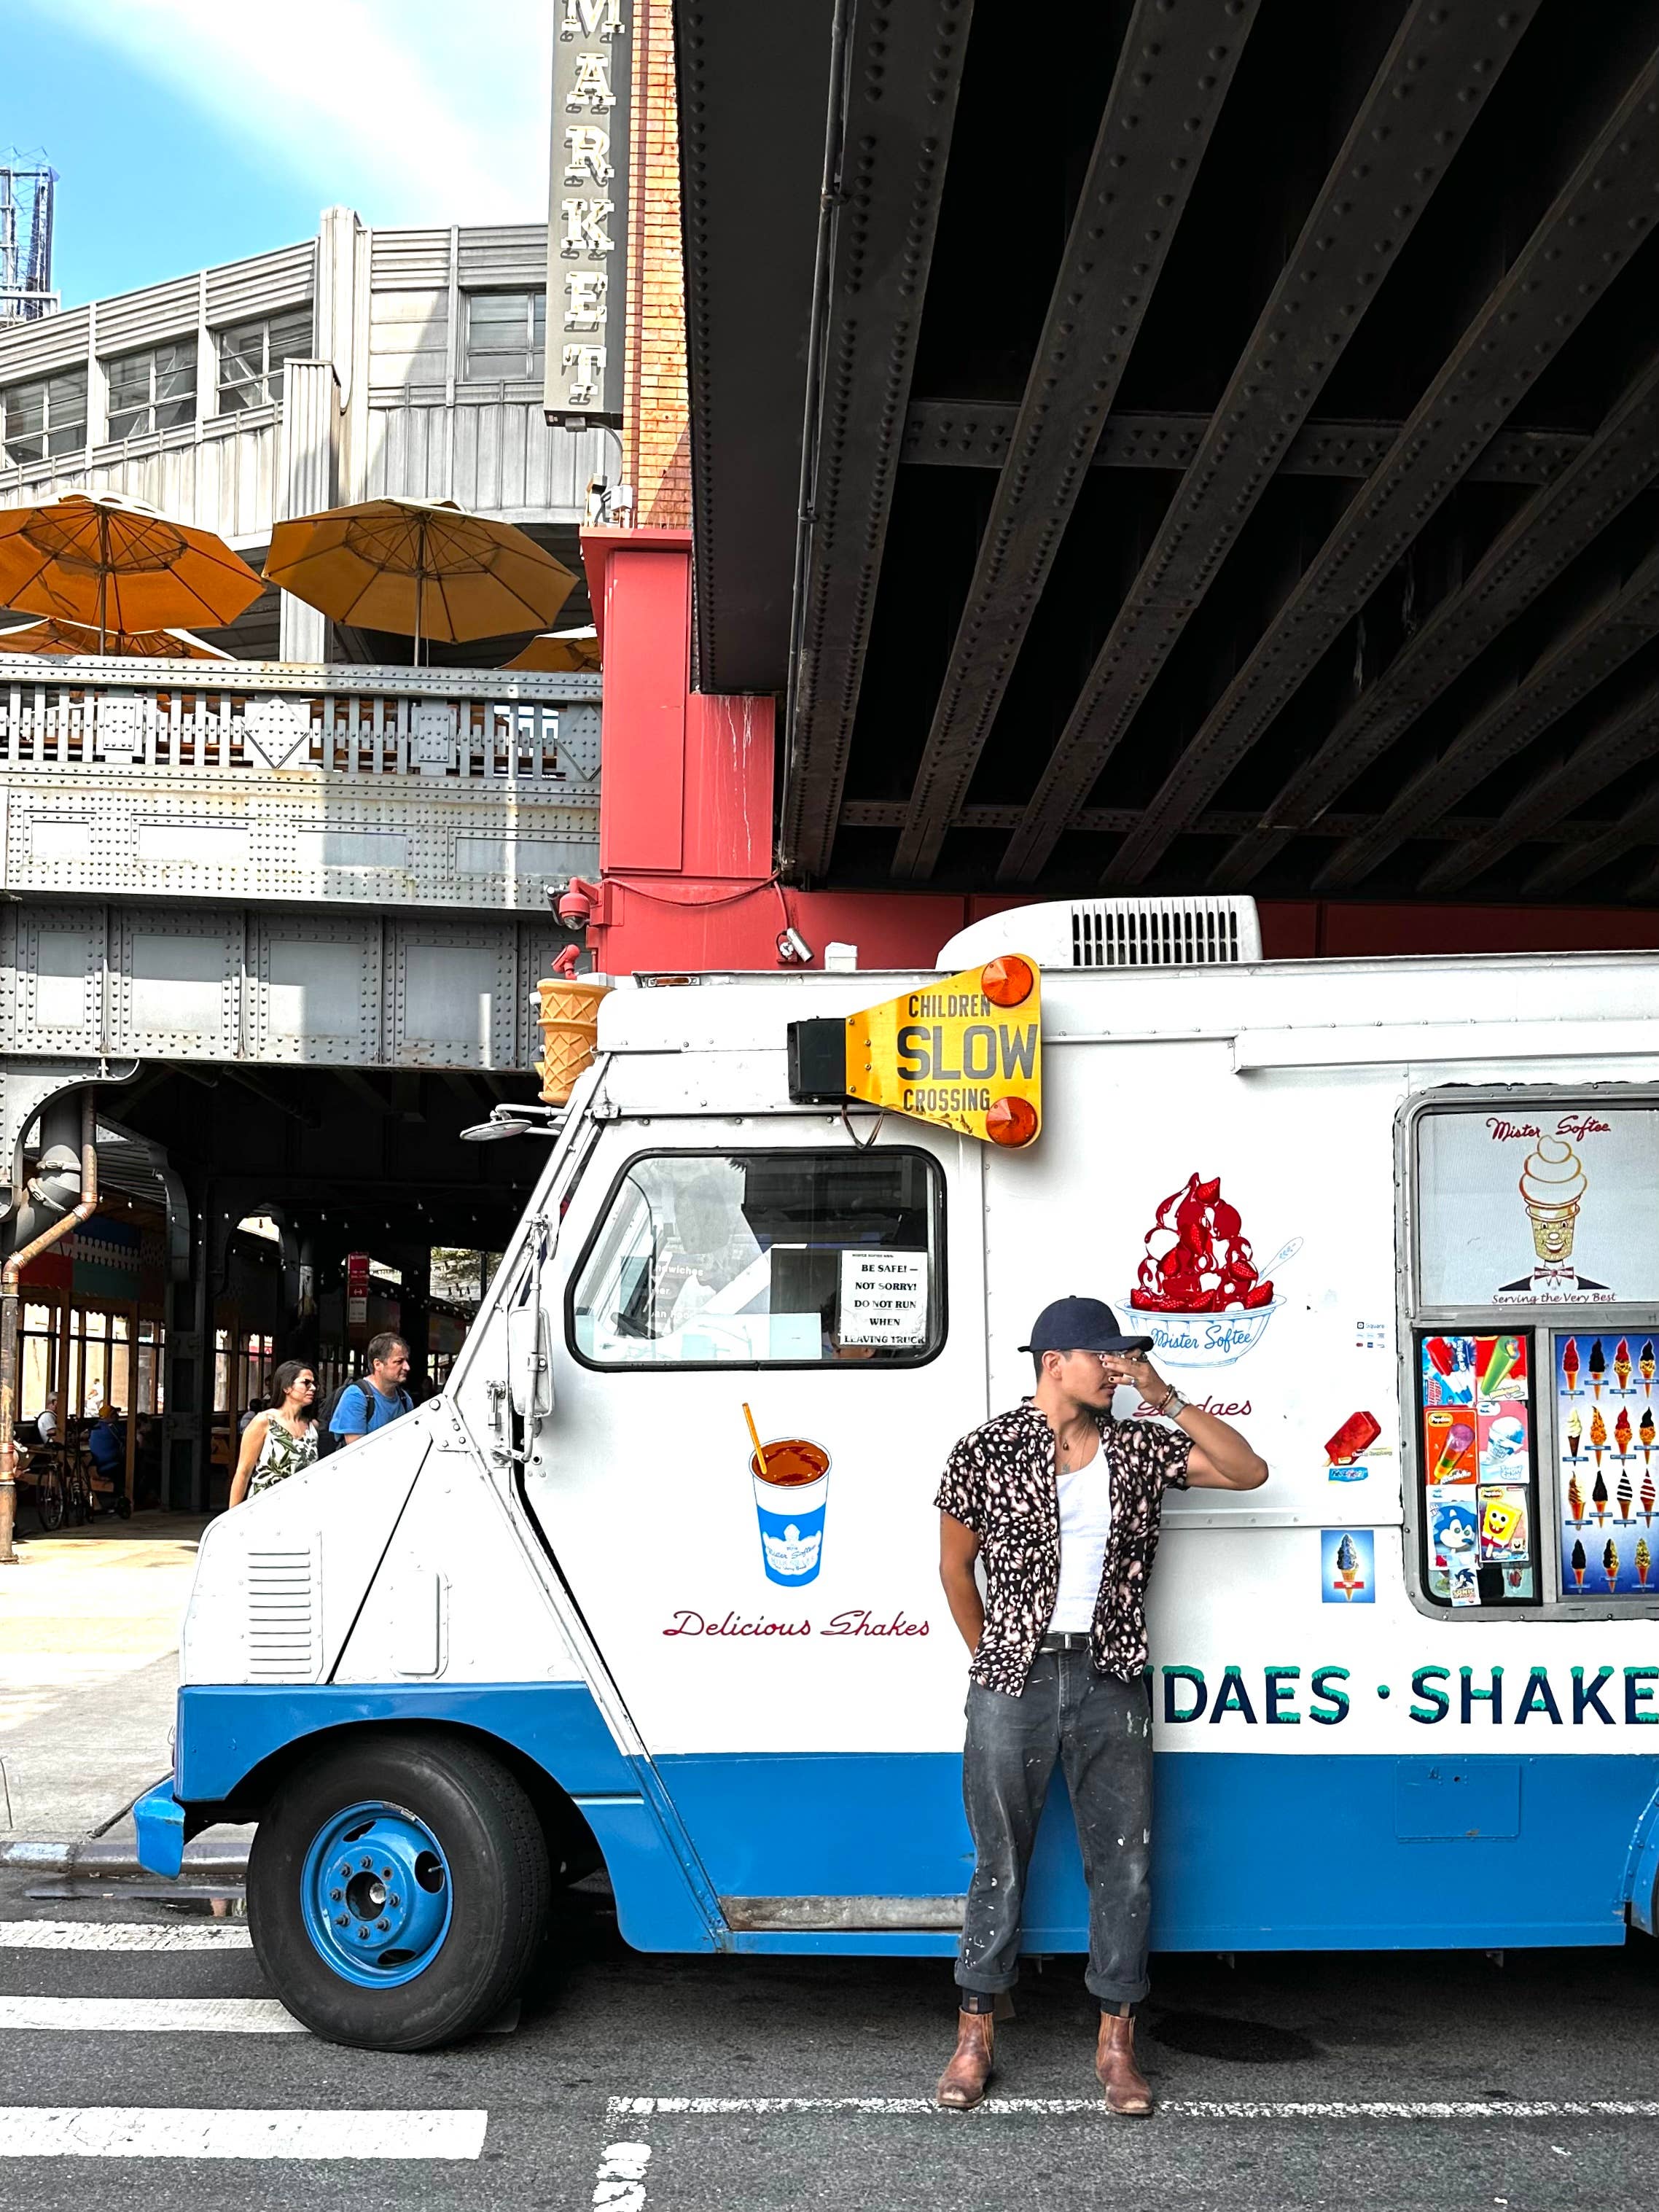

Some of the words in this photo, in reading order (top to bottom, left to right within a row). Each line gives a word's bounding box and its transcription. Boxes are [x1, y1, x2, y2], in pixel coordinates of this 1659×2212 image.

[561, 0, 625, 394] MARKET
[908, 994, 991, 1018] CHILDREN
[897, 1024, 1038, 1080] SLOW
[903, 1088, 991, 1113] CROSSING
[1486, 1117, 1540, 1142] Mister
[1555, 1115, 1612, 1142] Softee
[862, 1264, 875, 1272] BE
[878, 1265, 907, 1273] SAFE!
[855, 1282, 875, 1290] NOT
[878, 1282, 917, 1290] SORRY!
[1491, 1294, 1538, 1304] Serving
[1541, 1293, 1562, 1302] the
[1564, 1293, 1590, 1304] Very
[1592, 1292, 1617, 1302] Best
[854, 1300, 870, 1308] DO
[873, 1300, 893, 1308] NOT
[895, 1301, 916, 1309] RUN
[844, 1335, 888, 1344] LEAVING
[891, 1336, 925, 1344] TRUCK
[1150, 1328, 1199, 1349] Mister
[1204, 1325, 1252, 1353] Softee
[1132, 1395, 1252, 1417] Sdaes
[663, 1610, 811, 1637] Delicious
[820, 1610, 929, 1637] Shakes
[1408, 1664, 1659, 1726] SHAKE
